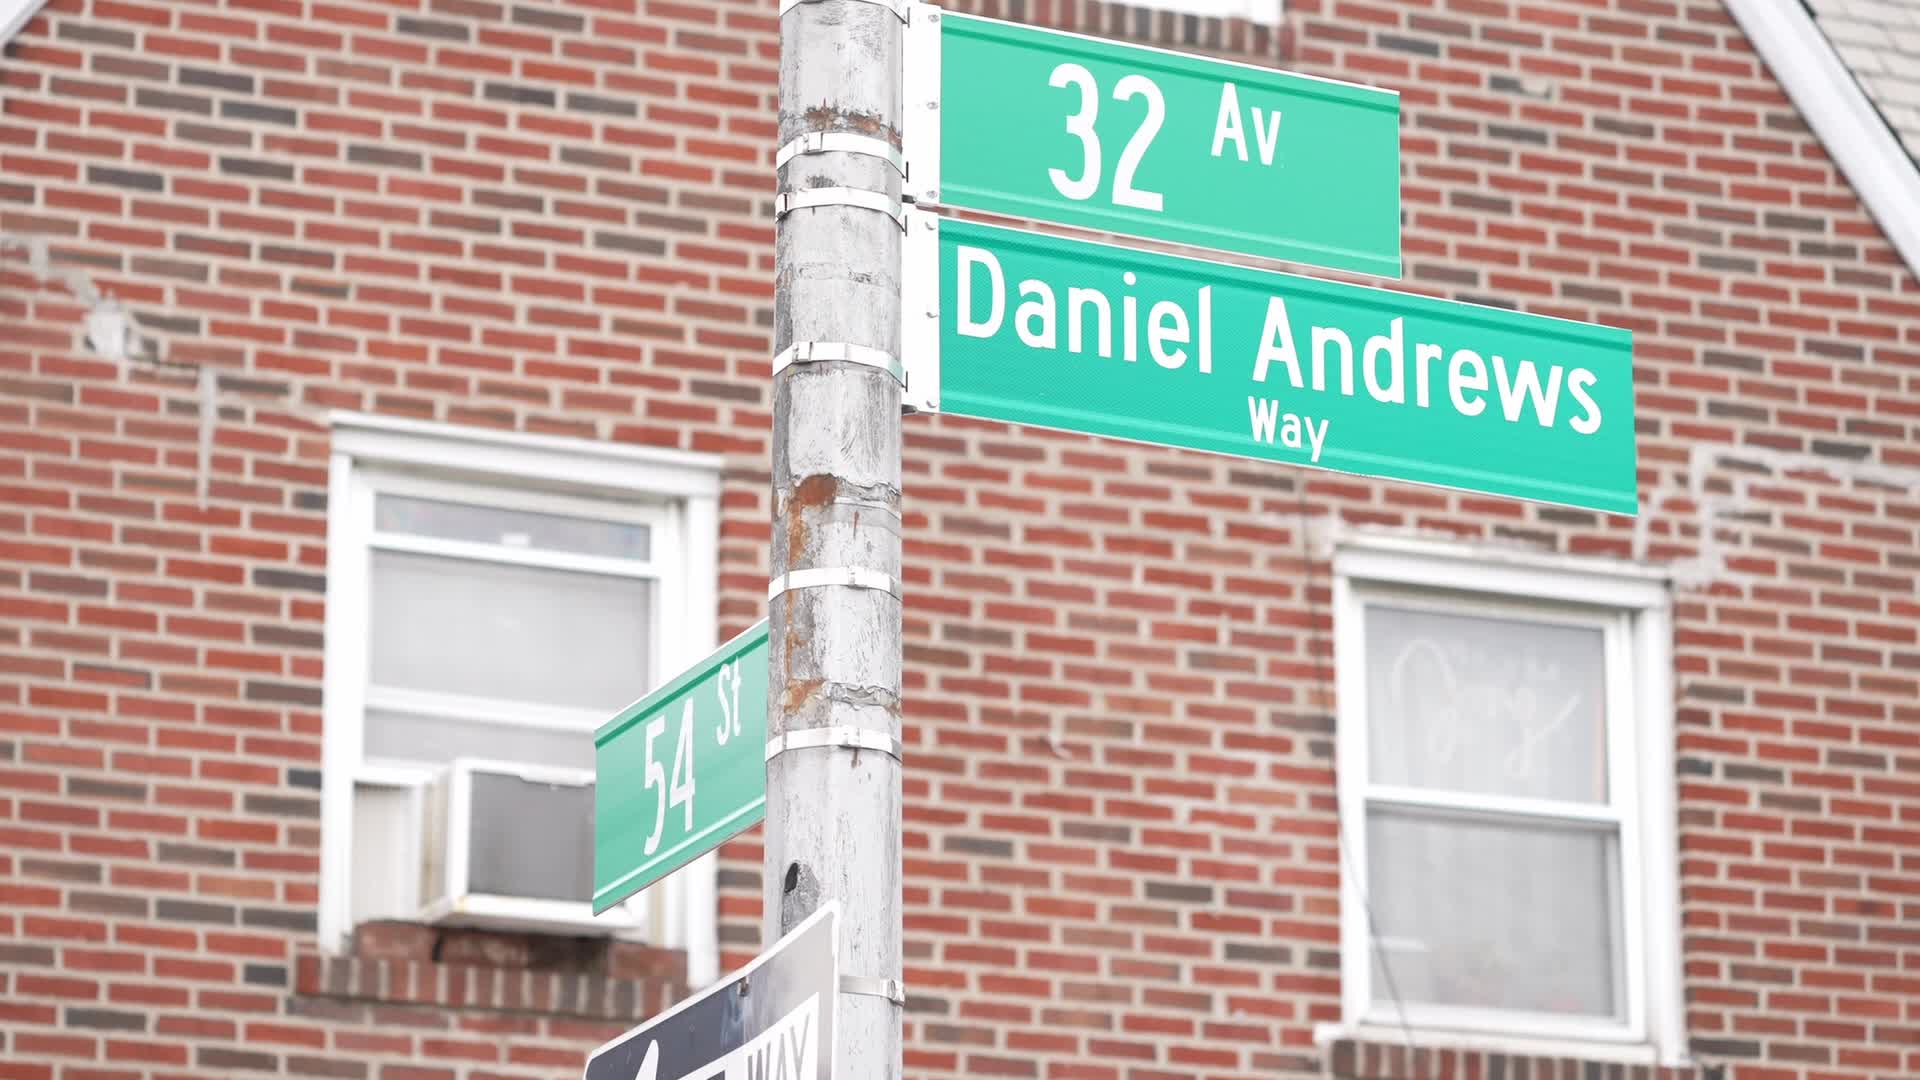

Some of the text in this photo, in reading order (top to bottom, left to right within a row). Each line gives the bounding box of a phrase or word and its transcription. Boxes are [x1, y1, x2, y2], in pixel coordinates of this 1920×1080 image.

[1048, 63, 1282, 212] 32 Av
[957, 245, 1602, 435] Daniel Andrews
[1247, 396, 1329, 463] Way
[642, 655, 742, 856] 54 St
